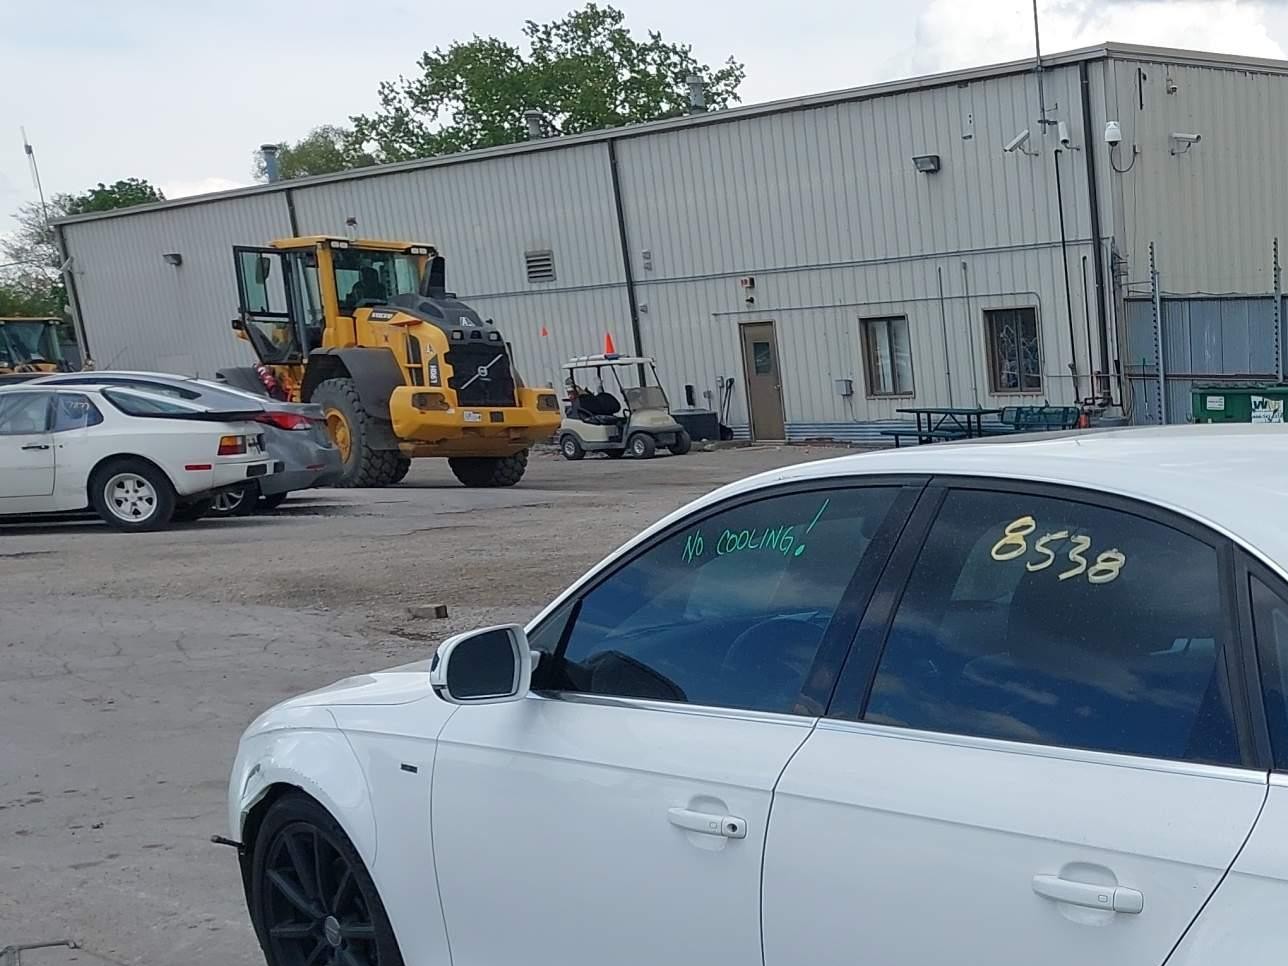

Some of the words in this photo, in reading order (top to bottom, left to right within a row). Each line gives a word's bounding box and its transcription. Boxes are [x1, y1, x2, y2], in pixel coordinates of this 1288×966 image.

[682, 529, 703, 564] NO
[717, 498, 829, 556] COOLING!
[991, 515, 1126, 584] 8538
